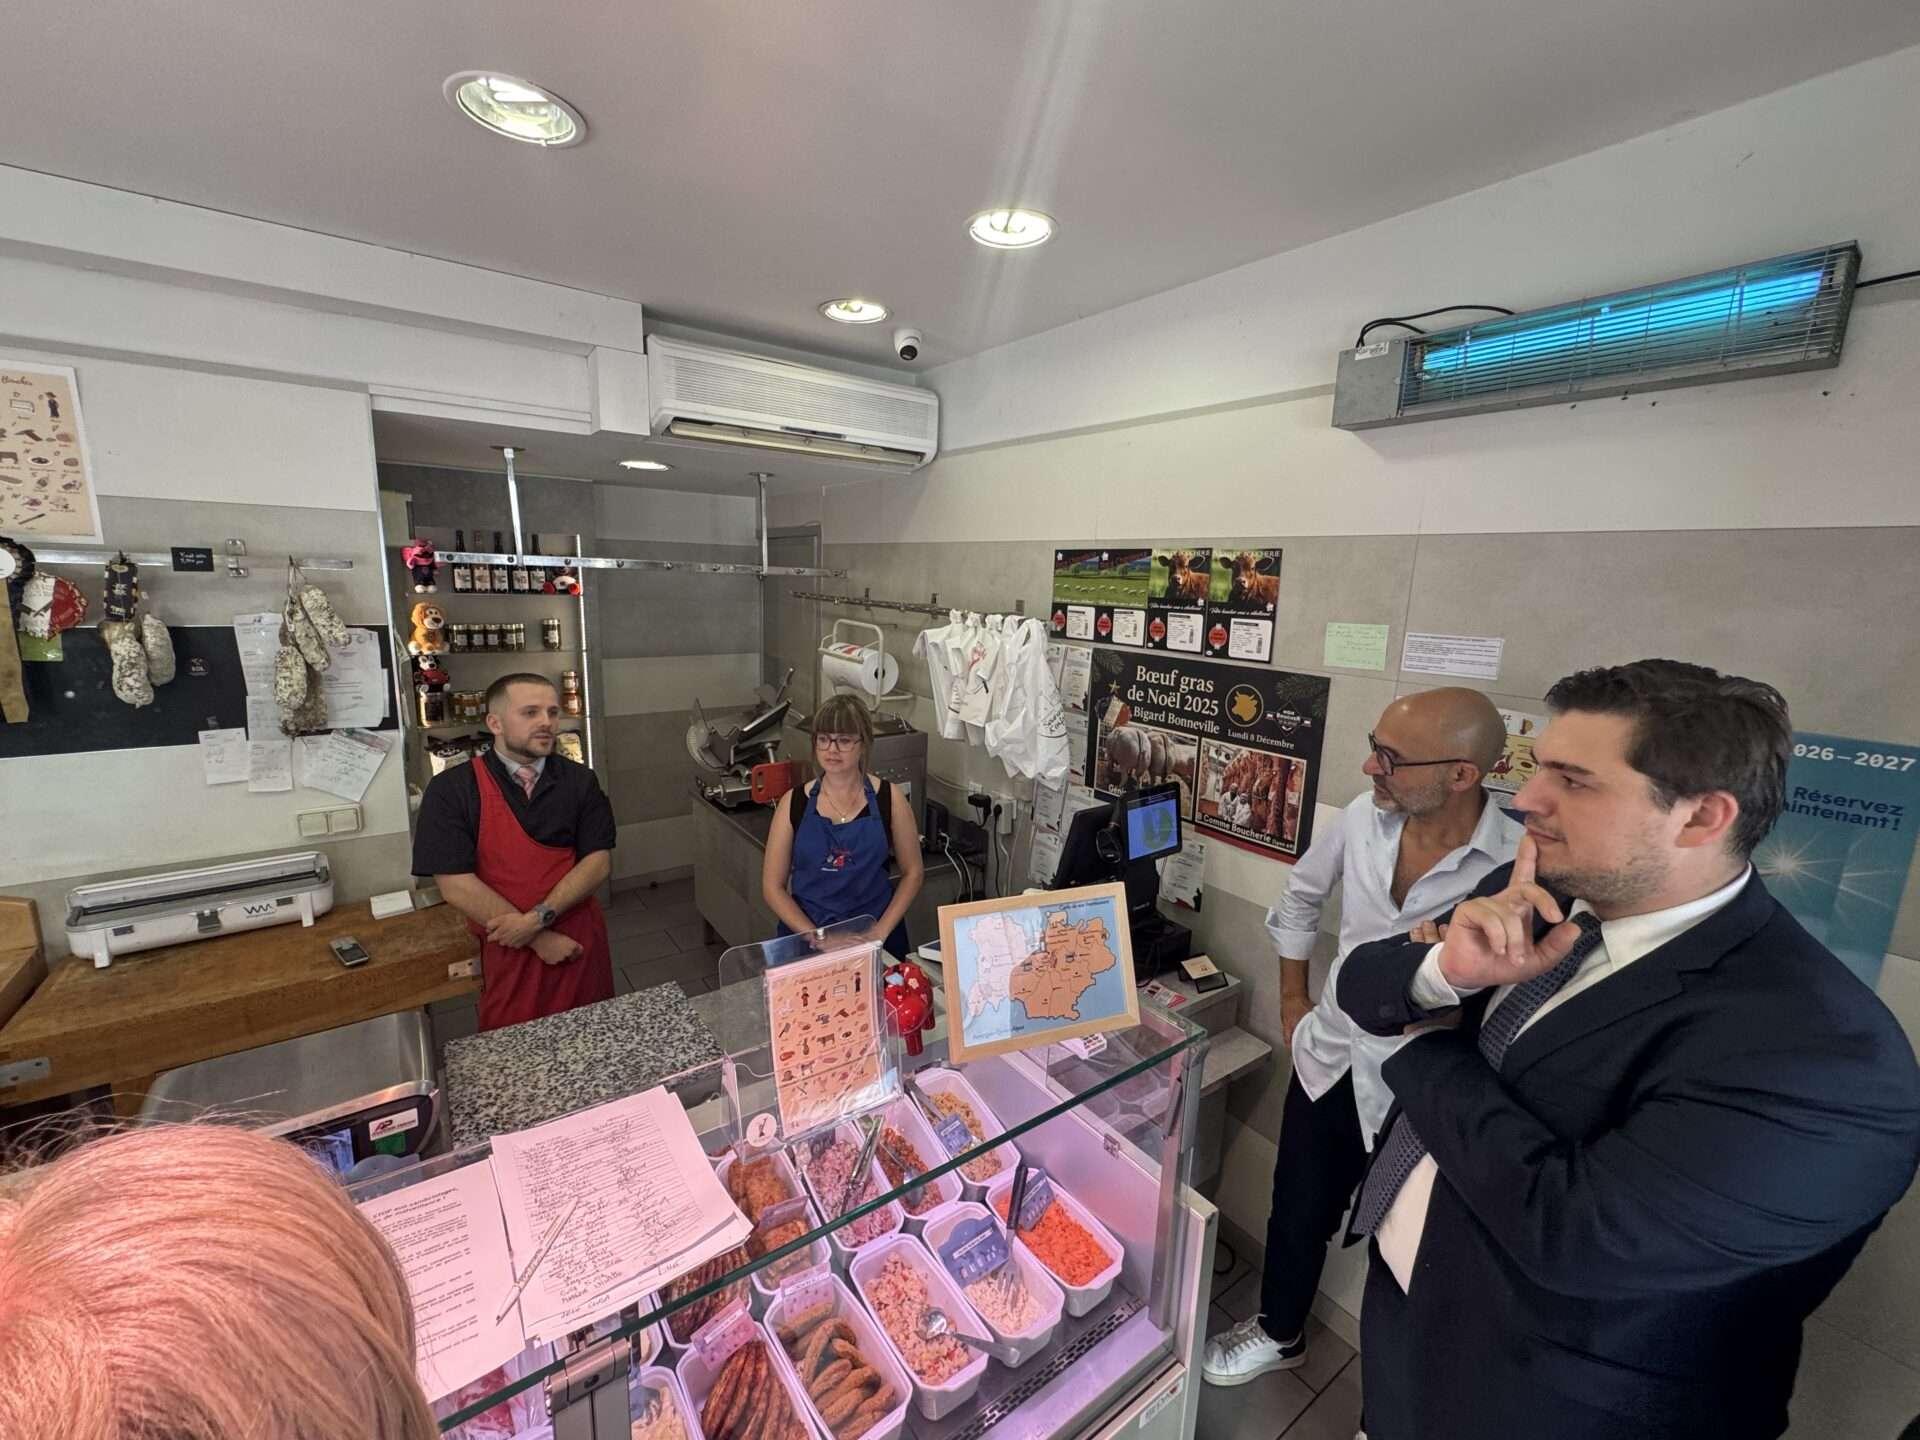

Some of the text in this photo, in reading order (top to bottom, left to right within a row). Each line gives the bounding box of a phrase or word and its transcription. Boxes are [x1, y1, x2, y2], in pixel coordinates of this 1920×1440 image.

[1136, 665, 1214, 693] Bœuf gras
[1127, 684, 1219, 717] de Noël 2025
[1133, 706, 1220, 734] Bigard Bonneville
[1227, 728, 1248, 740] Lundi
[1256, 734, 1295, 750] Décembre
[1783, 799, 1890, 830] aintenant
[1793, 786, 1905, 817] Réservez
[1203, 814, 1231, 830] Comme
[1231, 823, 1272, 843] Boucherie
